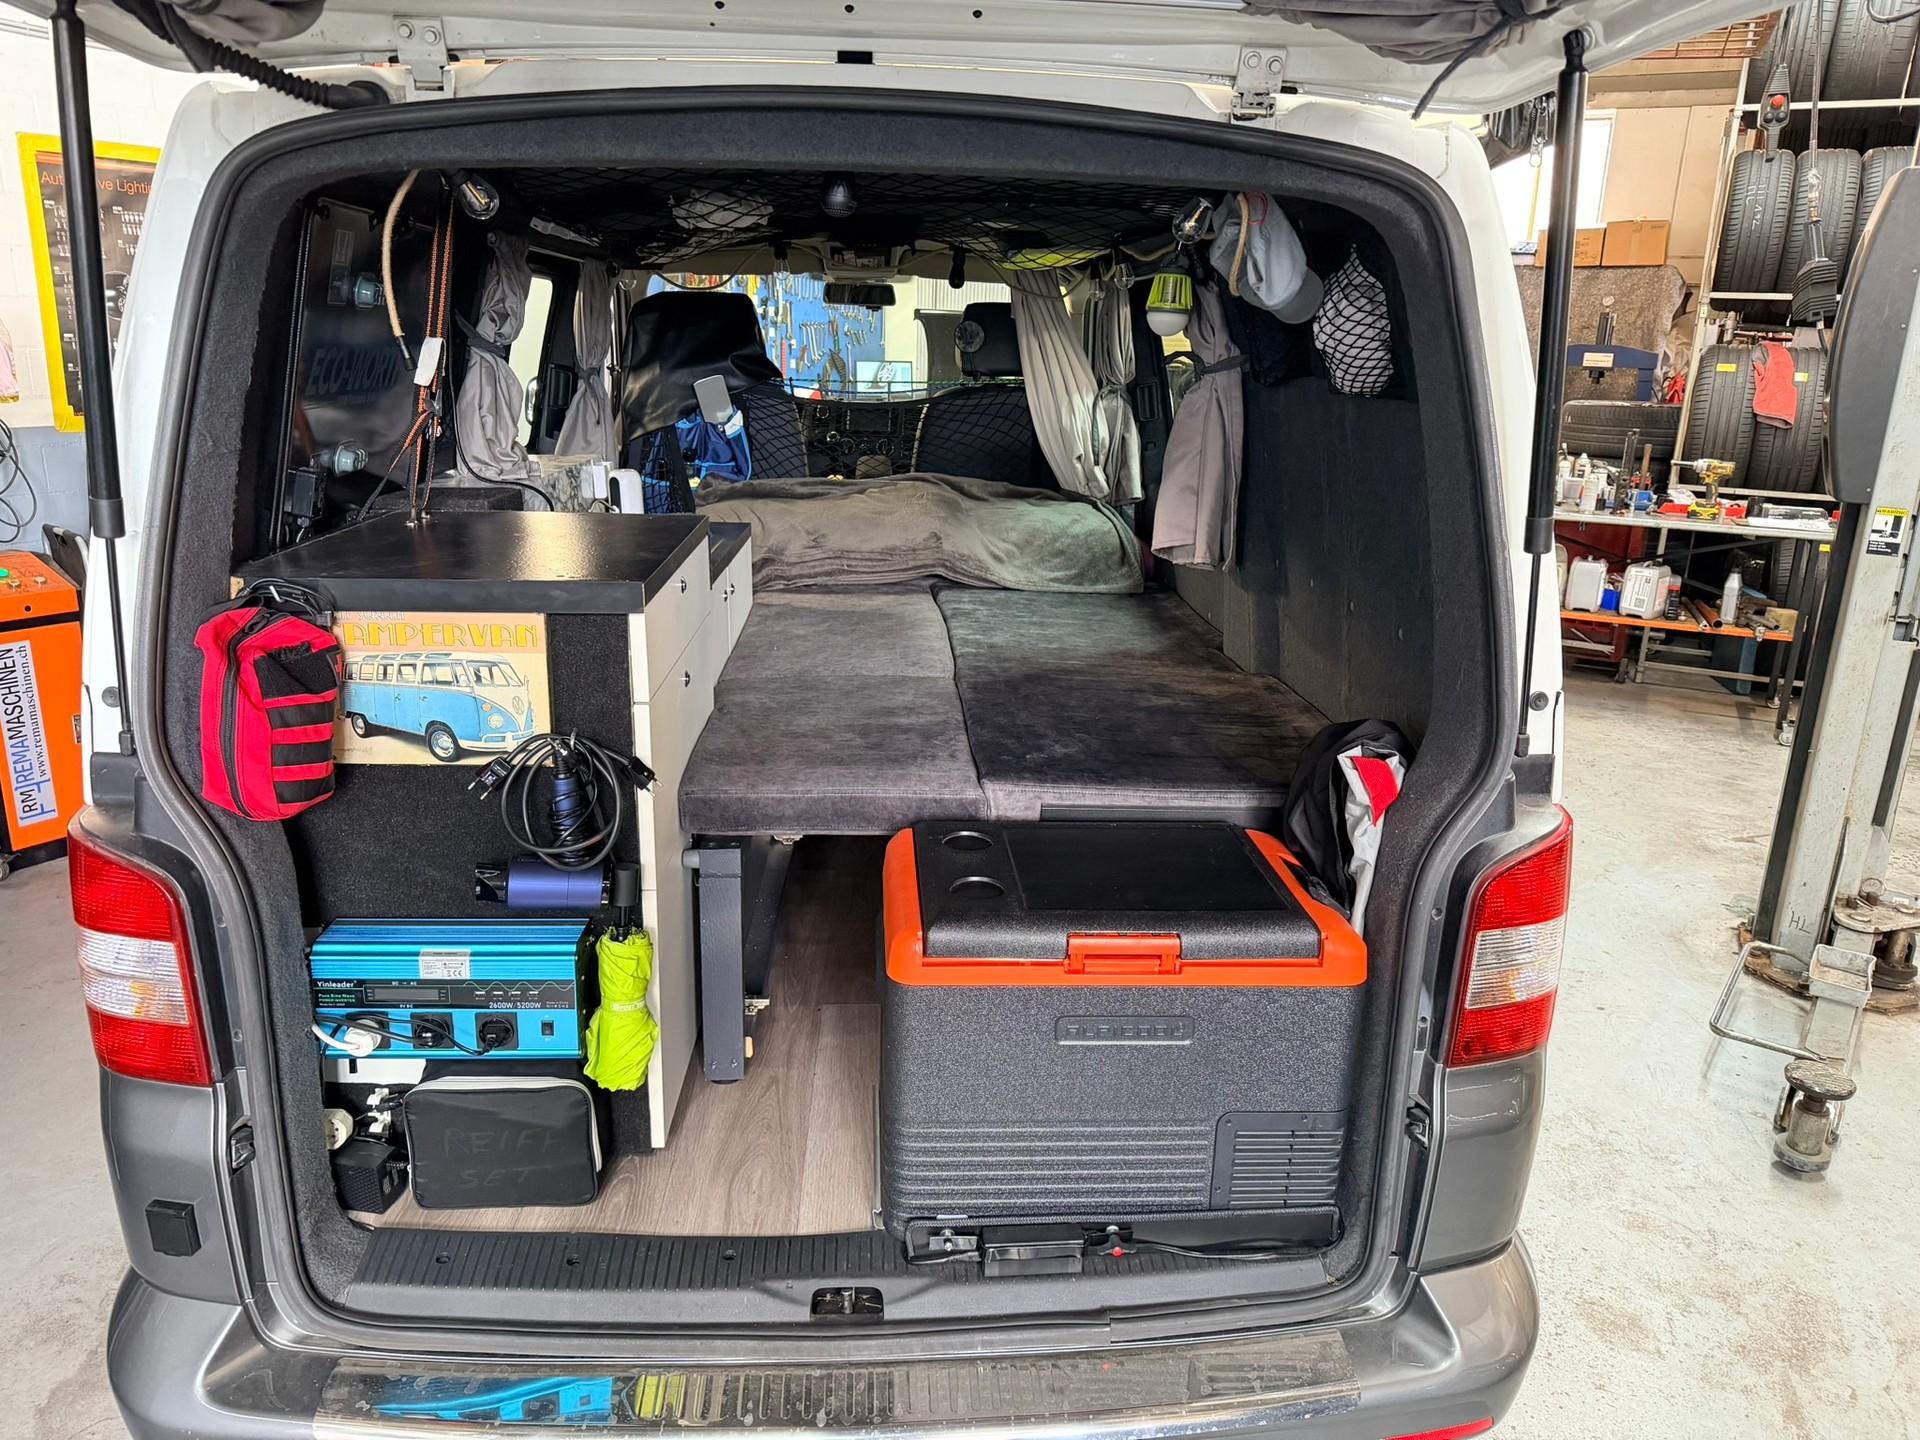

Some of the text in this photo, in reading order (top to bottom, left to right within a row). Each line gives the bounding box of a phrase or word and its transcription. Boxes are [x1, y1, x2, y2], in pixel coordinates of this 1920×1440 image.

[334, 623, 539, 647] AMPERVAN
[0, 647, 35, 784] REMAMASCHINEN
[15, 645, 47, 778] www.remamaschinen.ch
